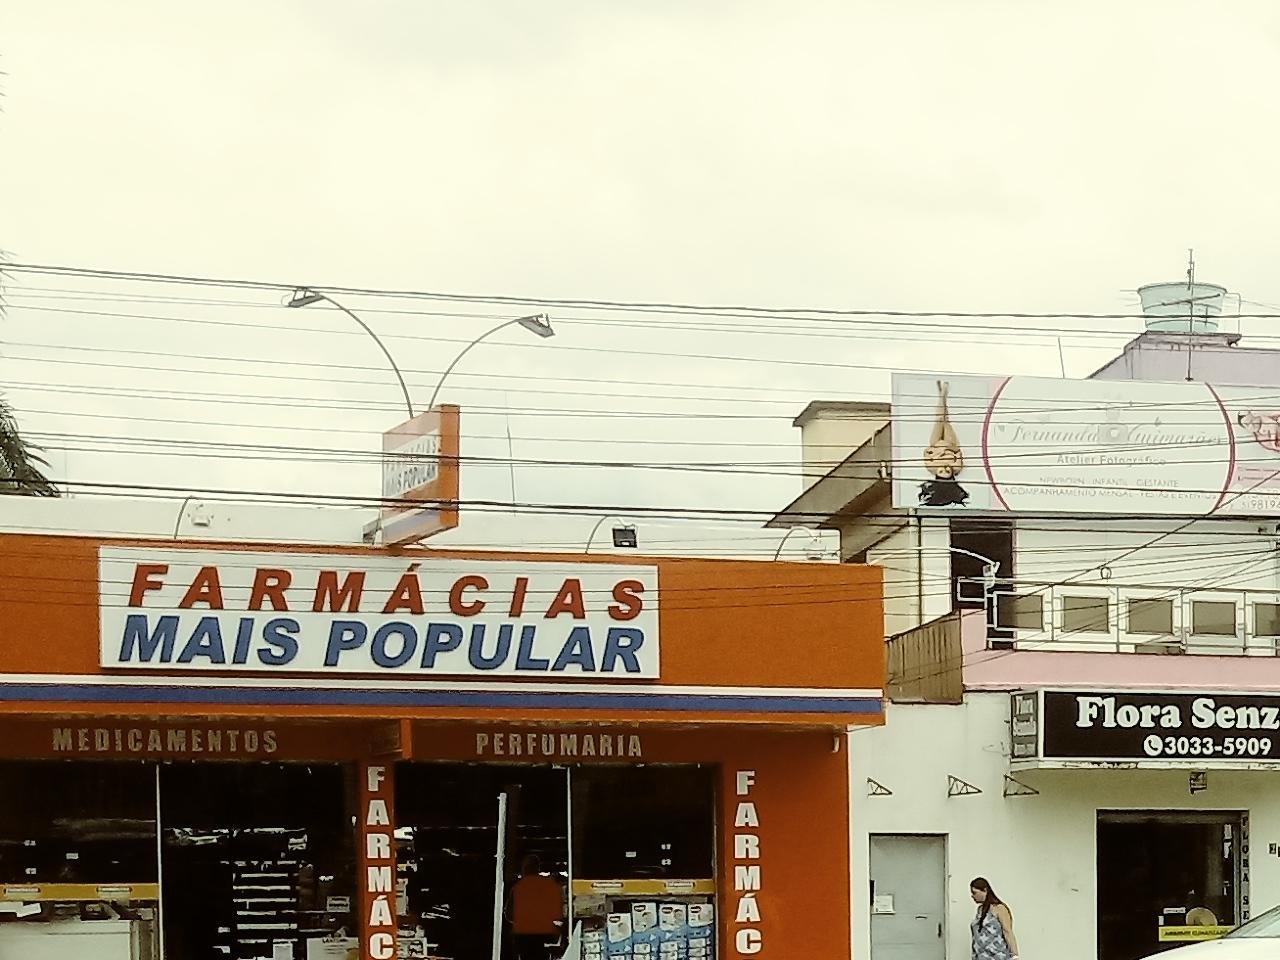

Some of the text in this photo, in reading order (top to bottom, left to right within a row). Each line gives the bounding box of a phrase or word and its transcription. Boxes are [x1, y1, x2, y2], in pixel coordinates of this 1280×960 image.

[1056, 454, 1096, 465] Atelier
[128, 562, 646, 622] FARMÁCIAS
[118, 613, 646, 674] MAIS POPULAR
[1075, 696, 1183, 728] Flora
[52, 727, 279, 753] MEDICAMENTOS
[475, 732, 644, 757] PERFUMARIA
[1163, 736, 1272, 757] 3033-5909
